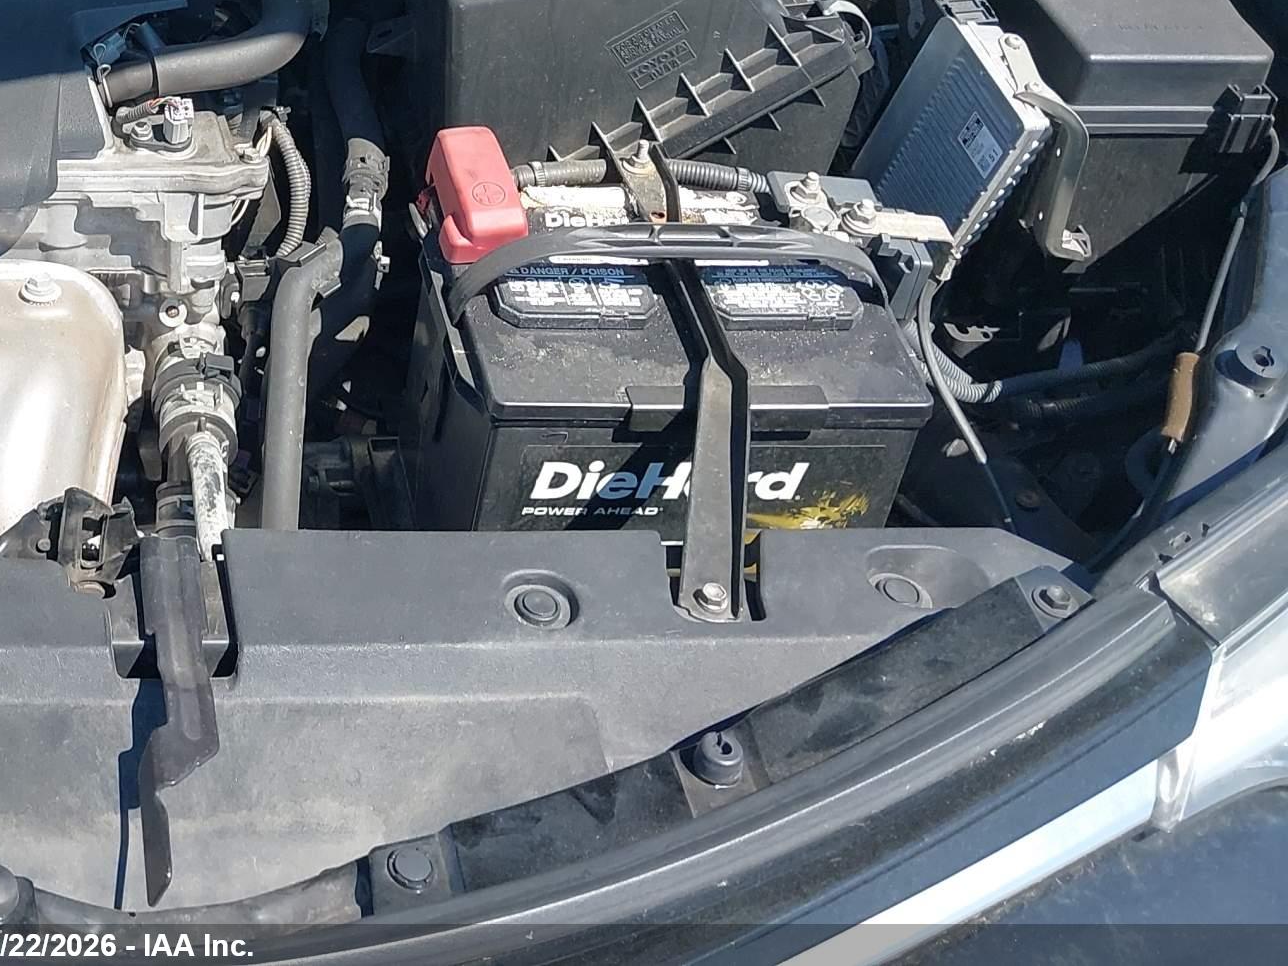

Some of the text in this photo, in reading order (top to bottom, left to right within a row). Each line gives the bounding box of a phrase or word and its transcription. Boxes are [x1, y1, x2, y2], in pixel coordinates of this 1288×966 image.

[520, 266, 568, 275] DANGER
[581, 267, 624, 276] POISON
[529, 460, 810, 501] DieHd
[521, 506, 659, 517] POWER AHEAD
